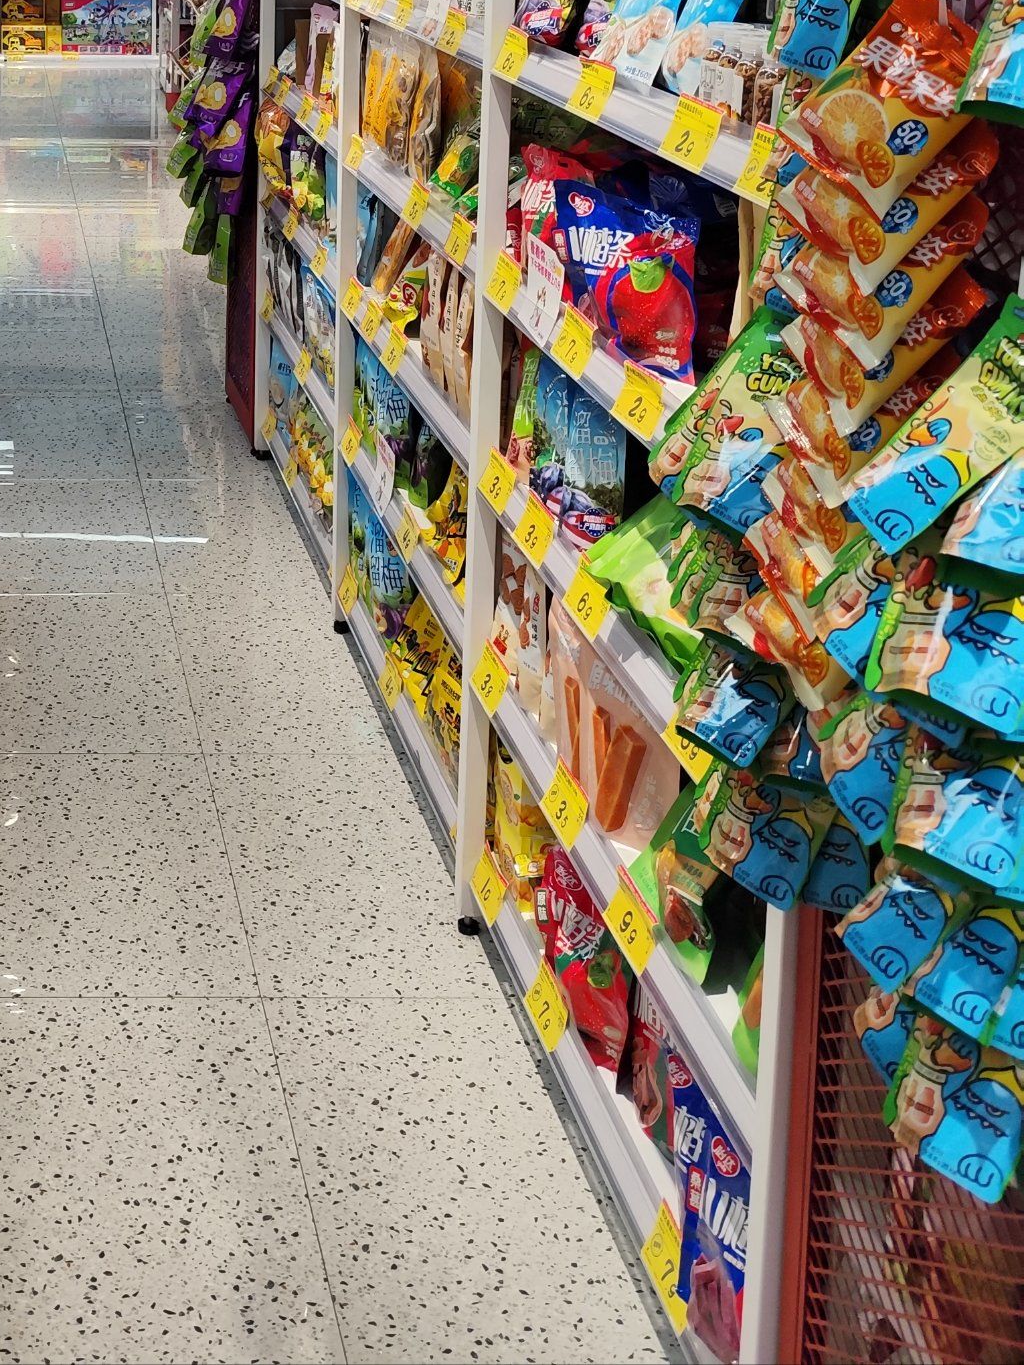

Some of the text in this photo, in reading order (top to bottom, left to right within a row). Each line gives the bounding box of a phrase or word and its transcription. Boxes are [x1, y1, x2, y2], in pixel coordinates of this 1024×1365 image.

[579, 87, 594, 110] 6.9
[674, 130, 695, 158] 2.9
[568, 225, 635, 269] 山楂条
[628, 396, 647, 423] 2.9
[489, 476, 502, 500] 3.9
[524, 524, 538, 549] 3.9
[577, 592, 592, 621] 6.9
[481, 674, 493, 698] 3.8
[555, 800, 568, 828] 3.5
[619, 910, 637, 945] 9.9
